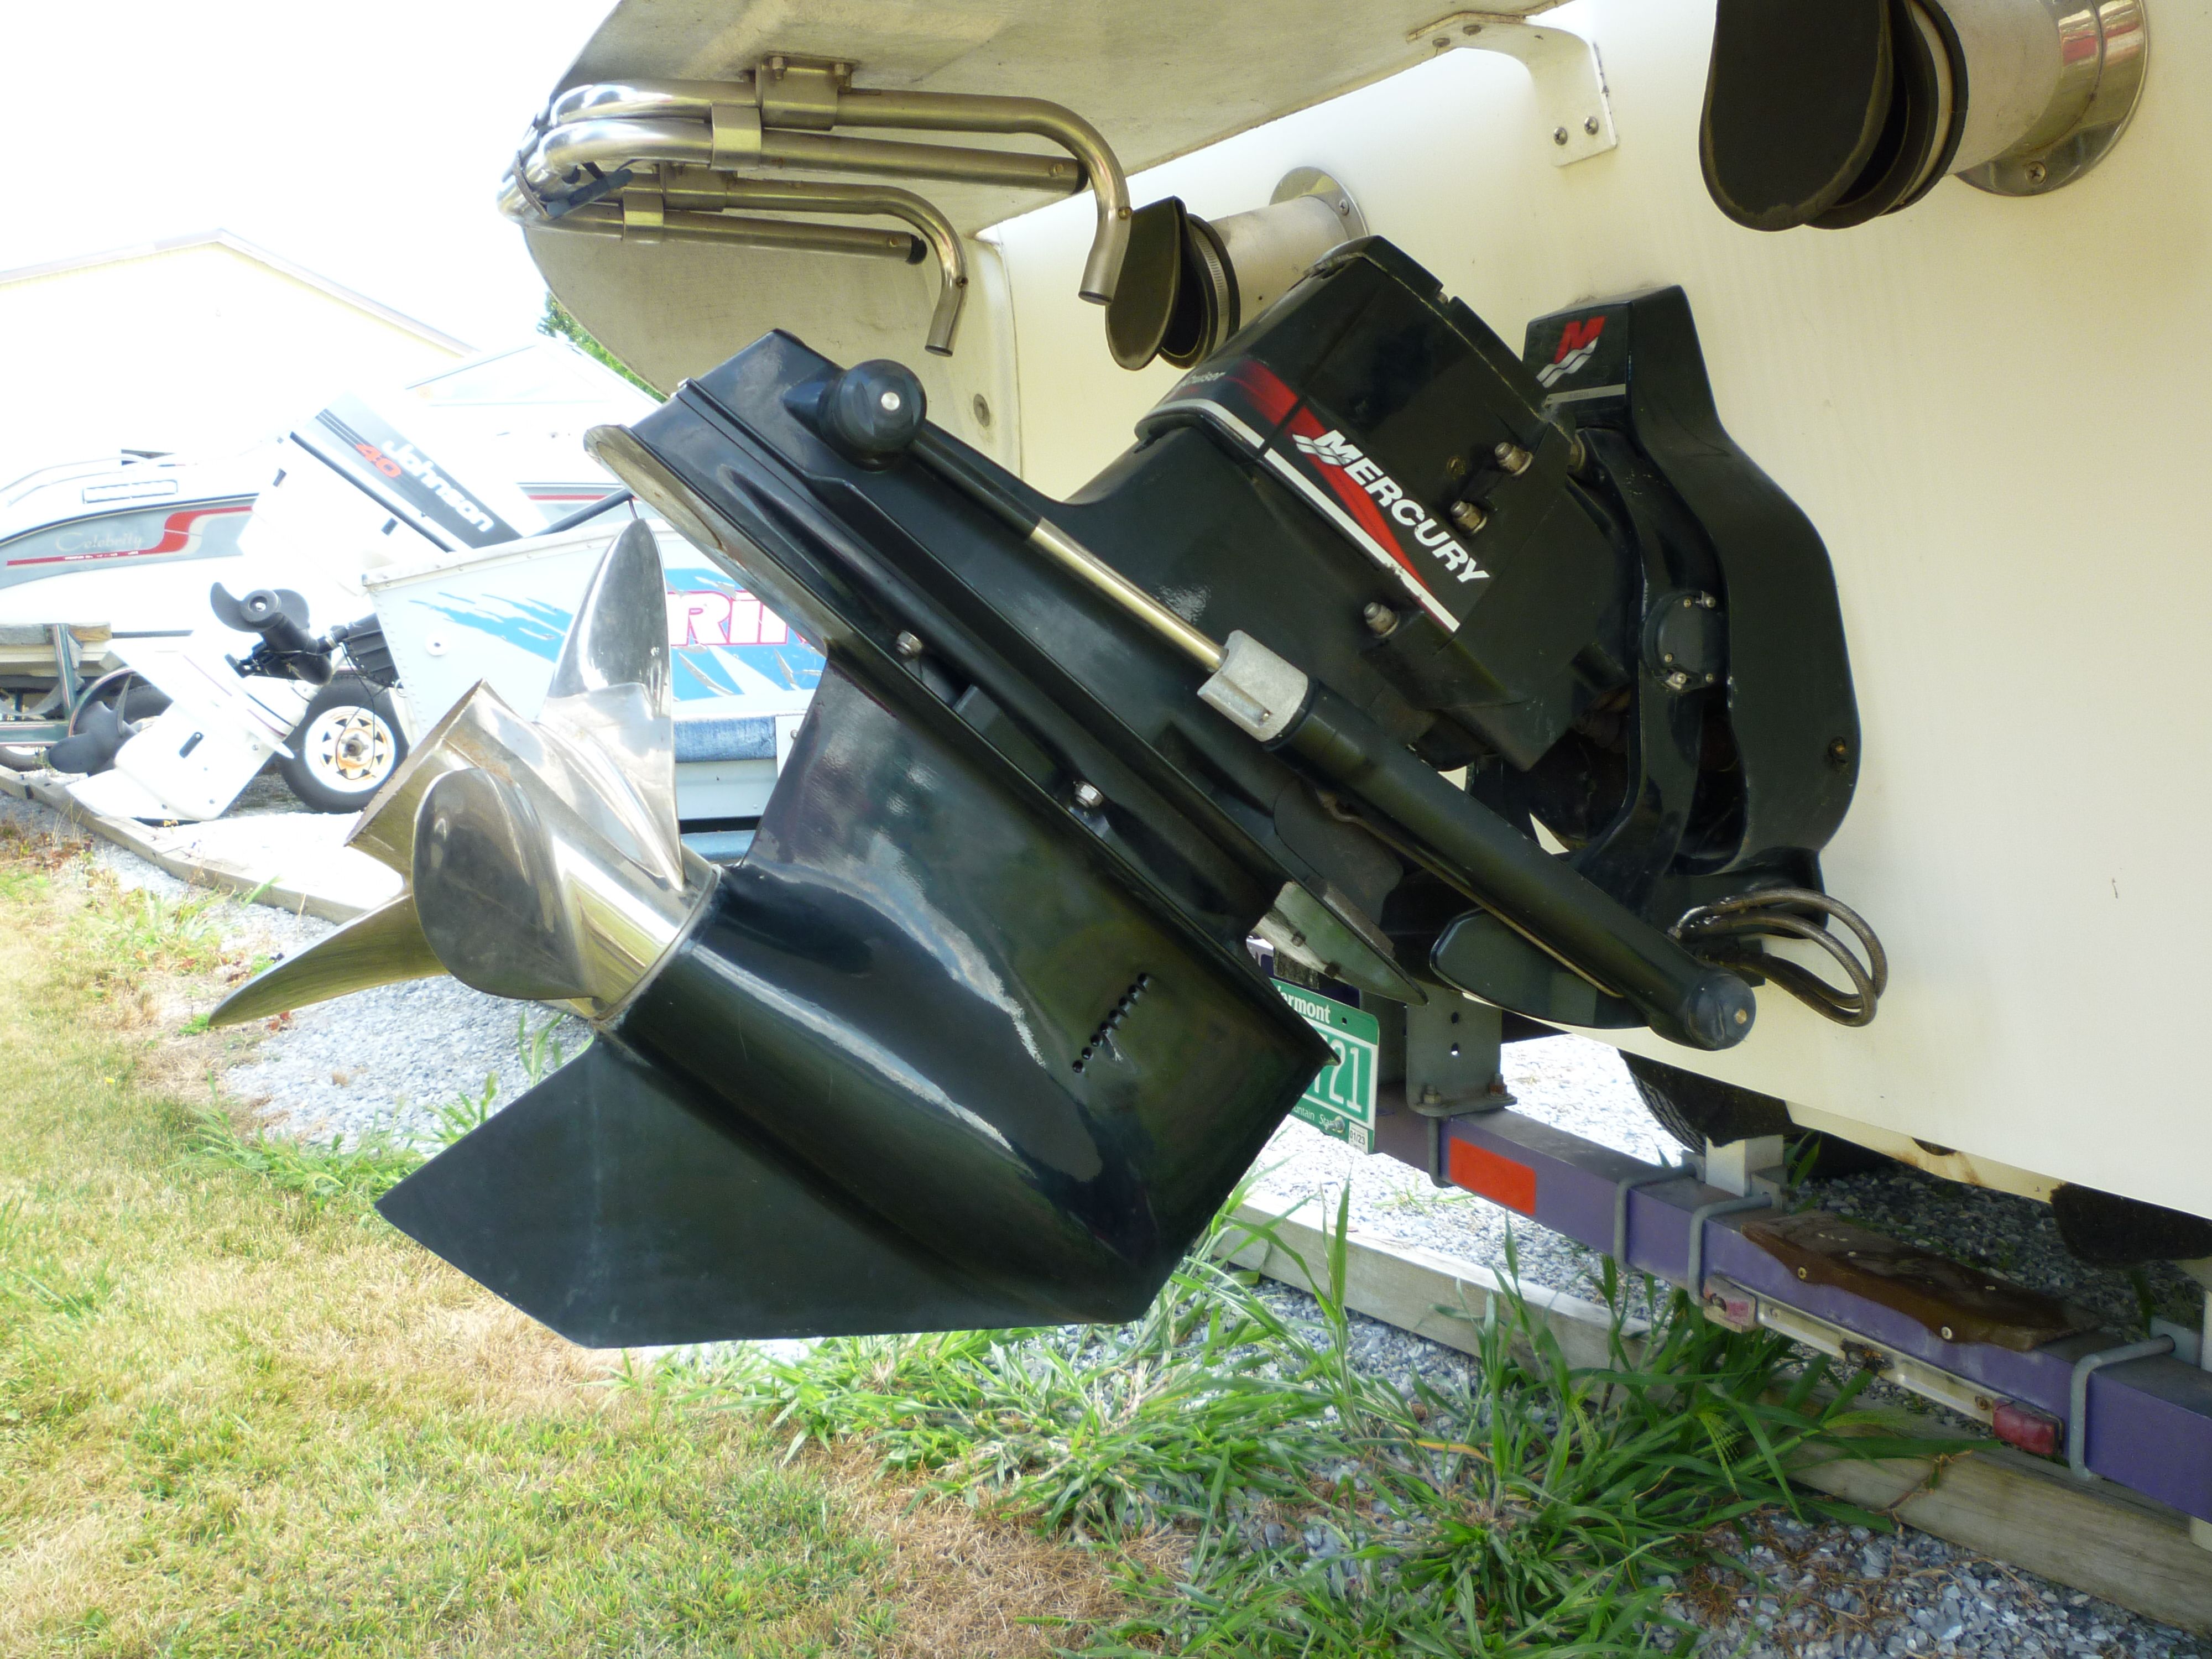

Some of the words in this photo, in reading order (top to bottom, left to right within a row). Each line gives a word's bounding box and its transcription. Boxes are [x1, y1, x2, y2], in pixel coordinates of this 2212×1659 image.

[382, 440, 494, 532] Johnson
[1312, 430, 1490, 583] MERCURY
[55, 532, 143, 550] Celebrity
[1277, 985, 1331, 1024] rmont
[1314, 1032, 1361, 1113] 21
[1292, 1106, 1315, 1121] untain
[1349, 1130, 1365, 1145] 01/23
